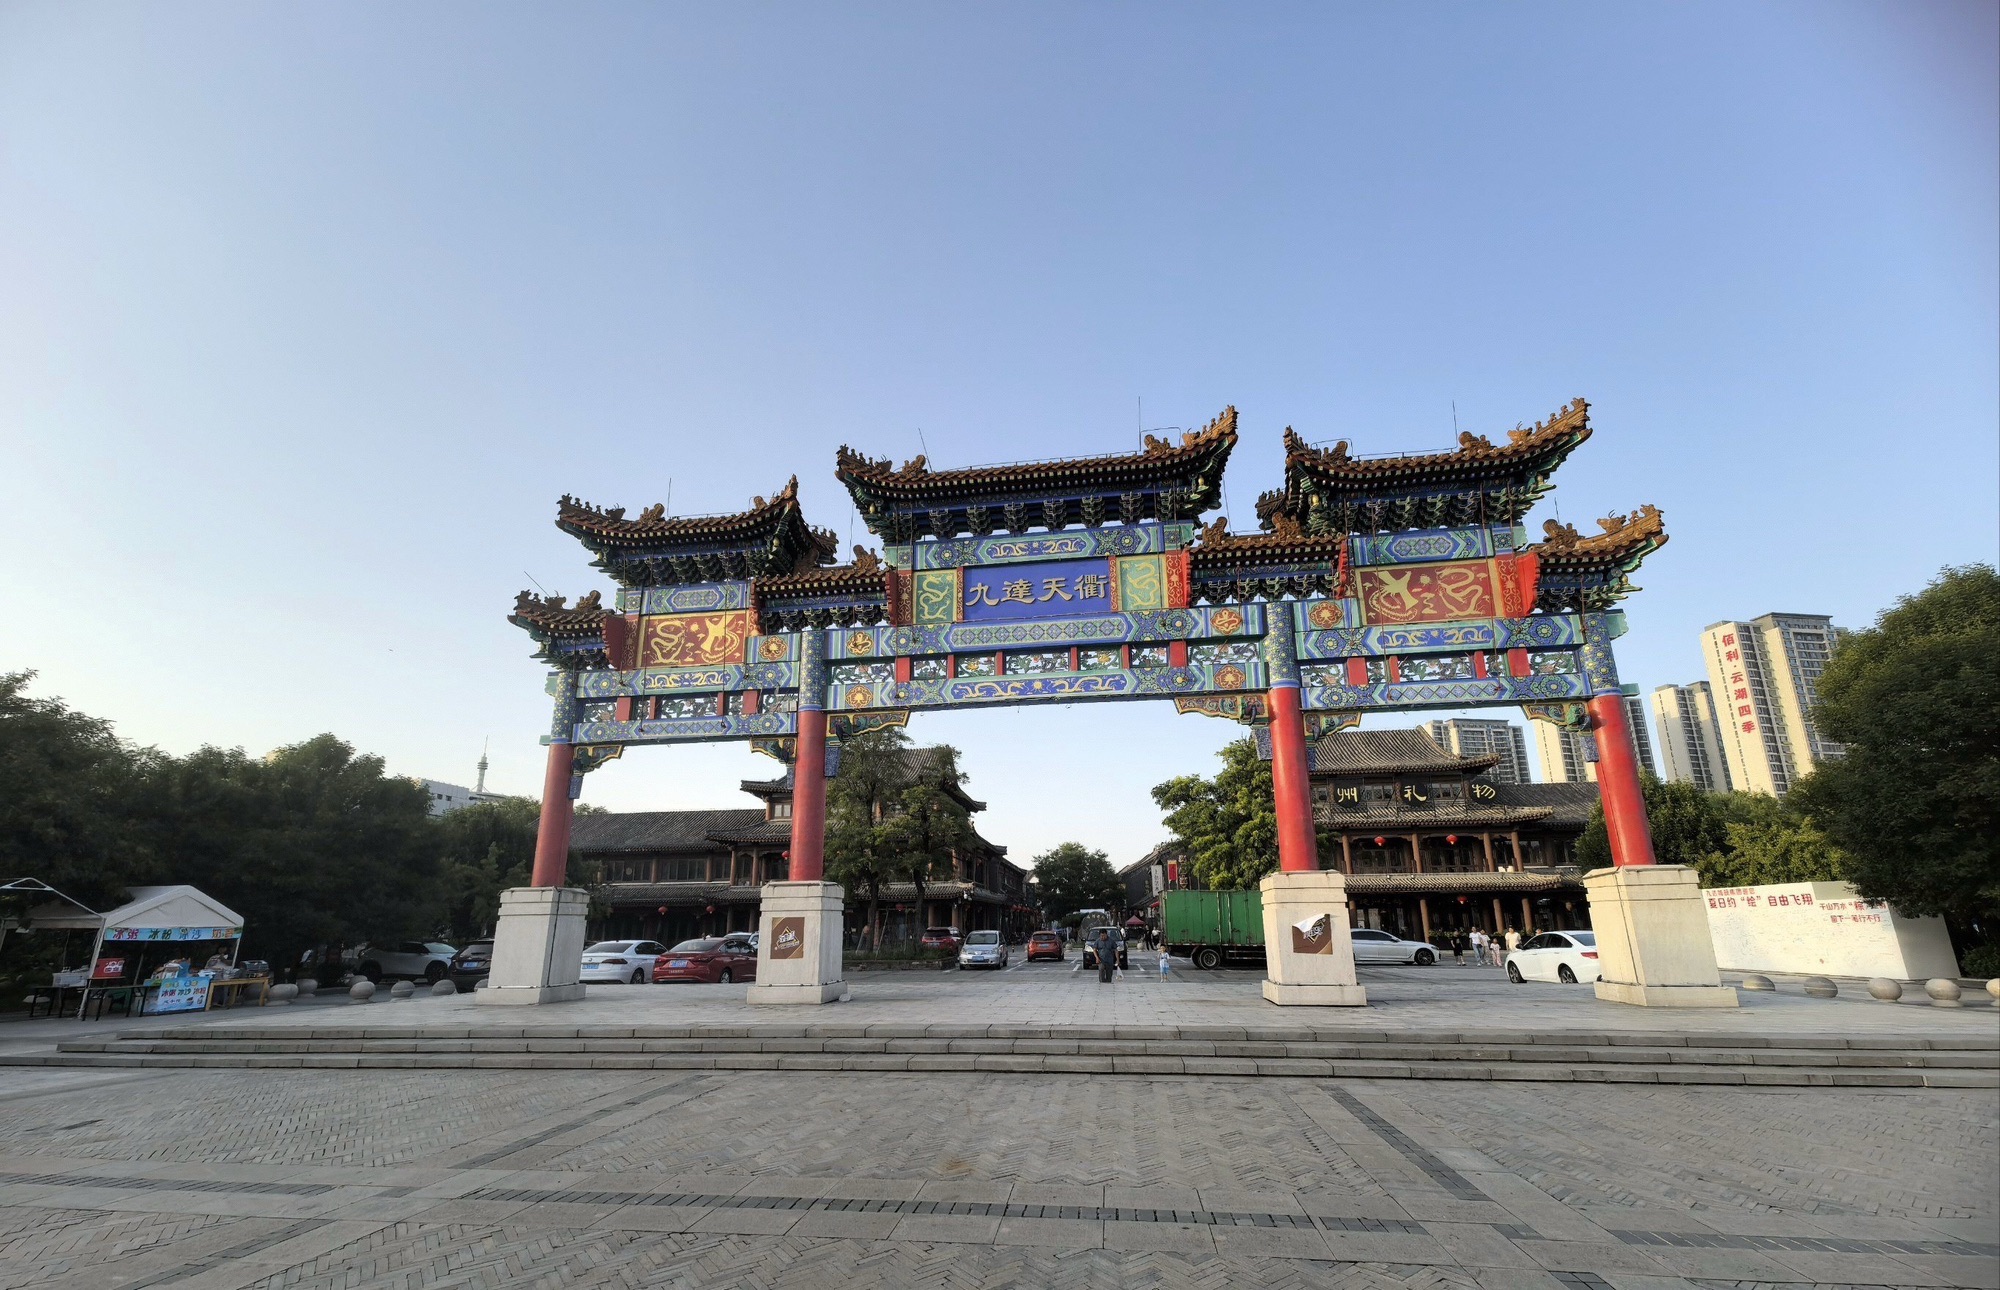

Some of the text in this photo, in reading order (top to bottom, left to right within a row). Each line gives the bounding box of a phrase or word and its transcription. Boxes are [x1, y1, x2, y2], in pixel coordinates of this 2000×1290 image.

[965, 574, 1109, 607] 九達天衢
[1767, 893, 1814, 907] 自由飞翔
